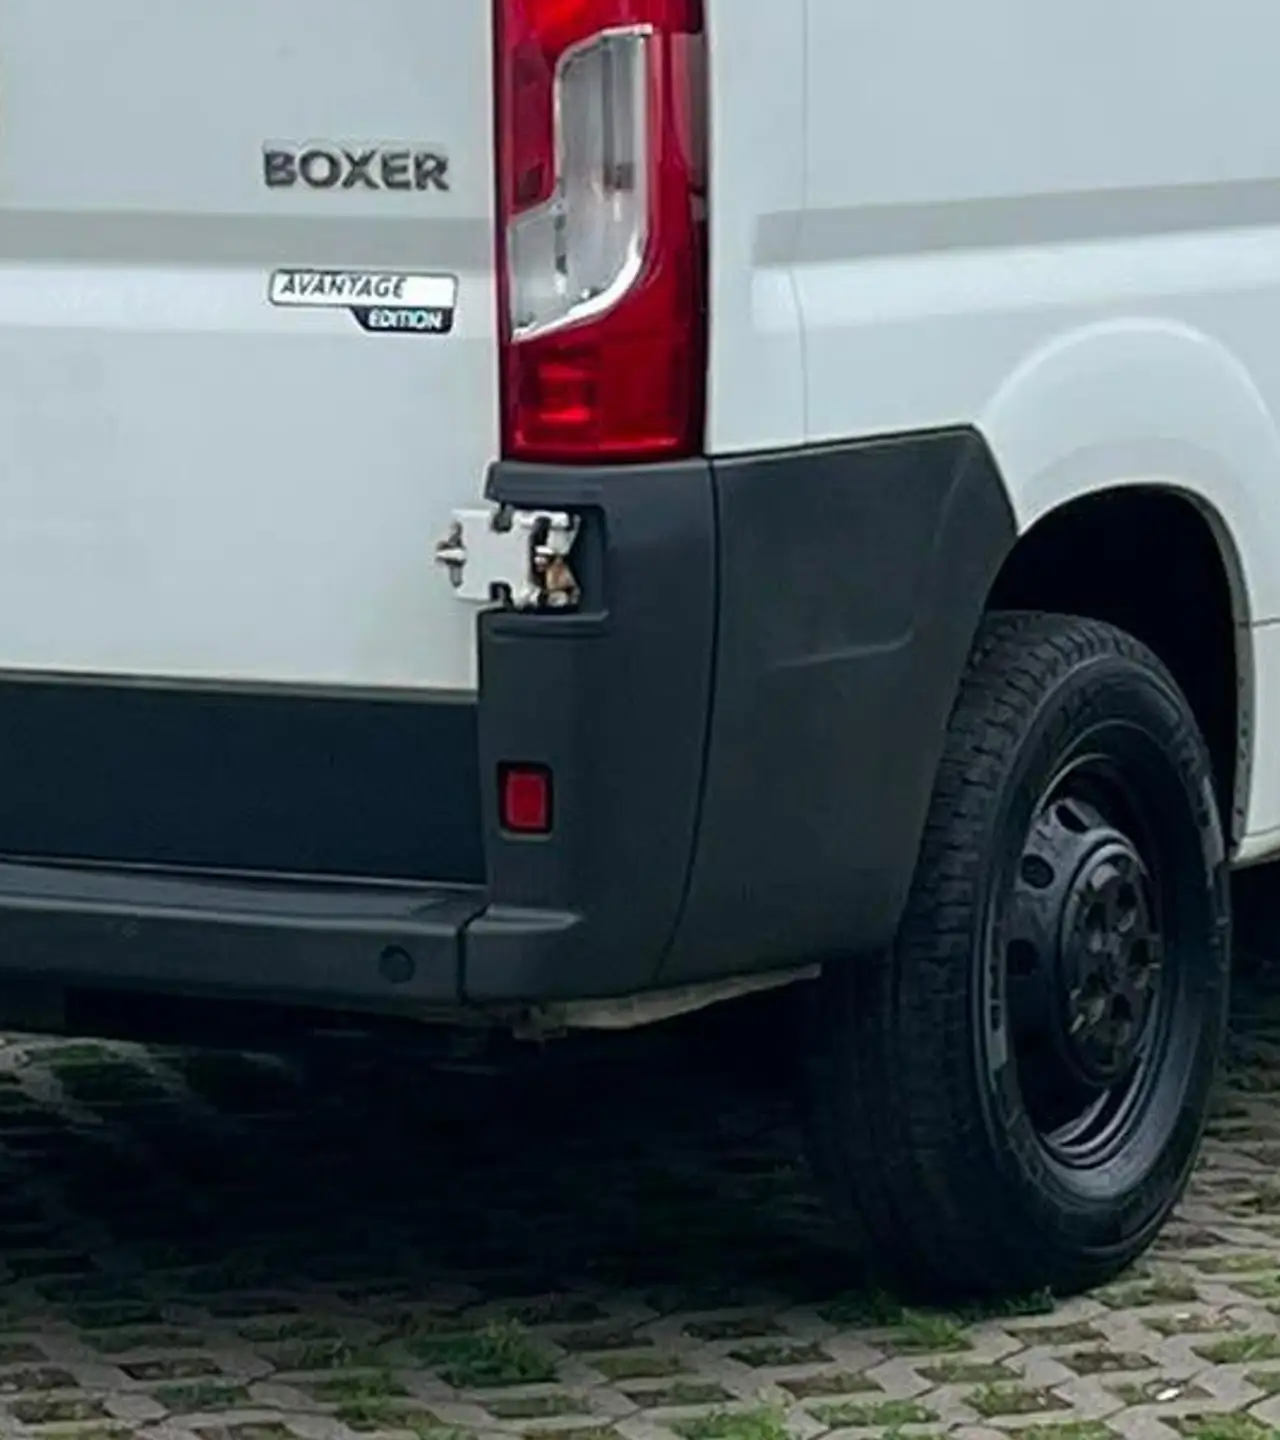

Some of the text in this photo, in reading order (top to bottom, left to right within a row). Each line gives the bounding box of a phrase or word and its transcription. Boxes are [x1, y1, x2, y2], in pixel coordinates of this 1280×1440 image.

[263, 148, 450, 192] BOXER
[280, 273, 408, 300] AVANTAGE
[368, 309, 443, 329] EDITION
